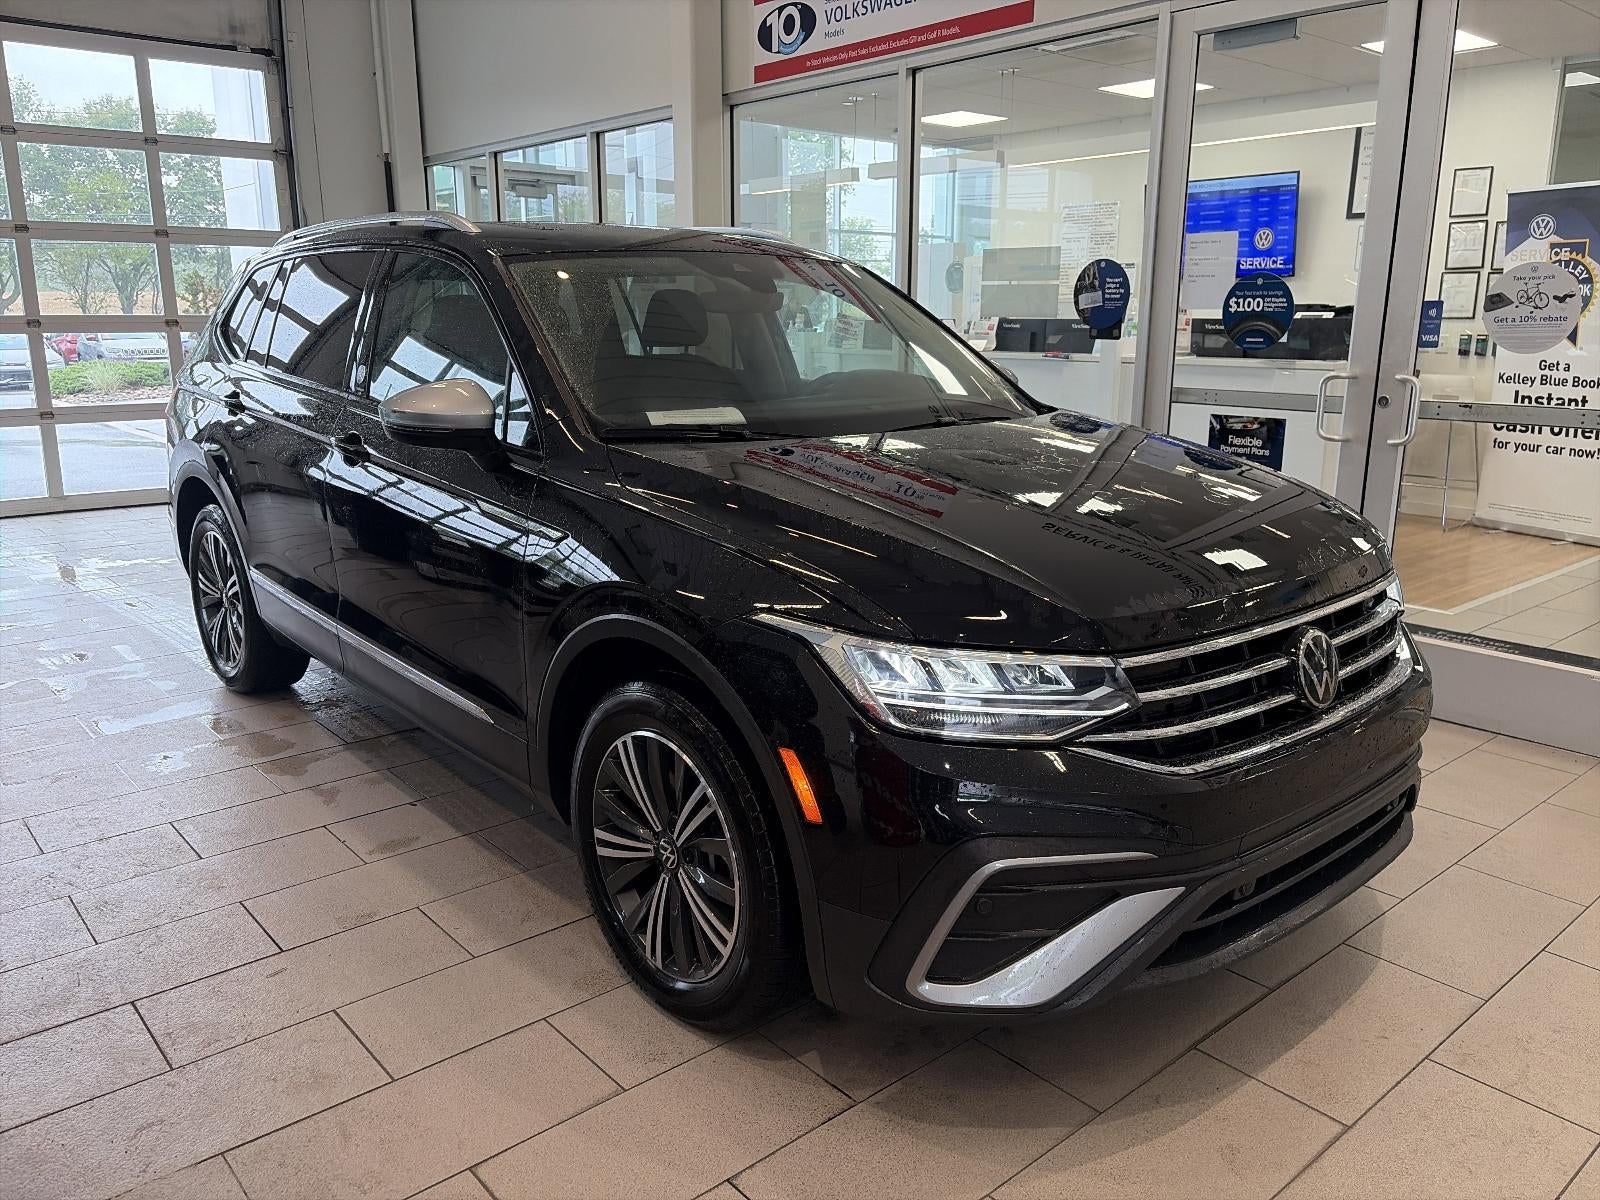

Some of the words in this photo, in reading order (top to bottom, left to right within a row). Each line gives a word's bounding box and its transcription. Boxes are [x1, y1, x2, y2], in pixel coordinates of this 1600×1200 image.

[824, 0, 917, 25] VOLKSWA
[766, 5, 800, 52] 10
[824, 27, 845, 39] Models
[822, 55, 838, 64] Vehicles
[849, 49, 858, 57] Past
[858, 47, 869, 55] Sales
[918, 33, 926, 41] and
[927, 30, 937, 39] Golf
[1510, 247, 1571, 262] SERVICE
[1239, 257, 1284, 269] SERVICE
[1228, 296, 1264, 313] $100
[1493, 315, 1510, 324] Get
[1519, 315, 1537, 323] 10%
[1539, 314, 1568, 323] rebate
[1538, 359, 1560, 372] Get
[1563, 362, 1571, 372] a
[1497, 372, 1537, 388] Kelley
[1539, 374, 1569, 387] Blue
[1571, 376, 1600, 389] Book
[1513, 389, 1589, 407] Instant
[1228, 434, 1263, 447] Flexible
[1493, 437, 1511, 450] for
[1513, 441, 1543, 453] your
[1545, 444, 1566, 455] car
[1568, 447, 1600, 460] now!
[1220, 444, 1251, 455] Payment
[1251, 447, 1270, 456] Plans
